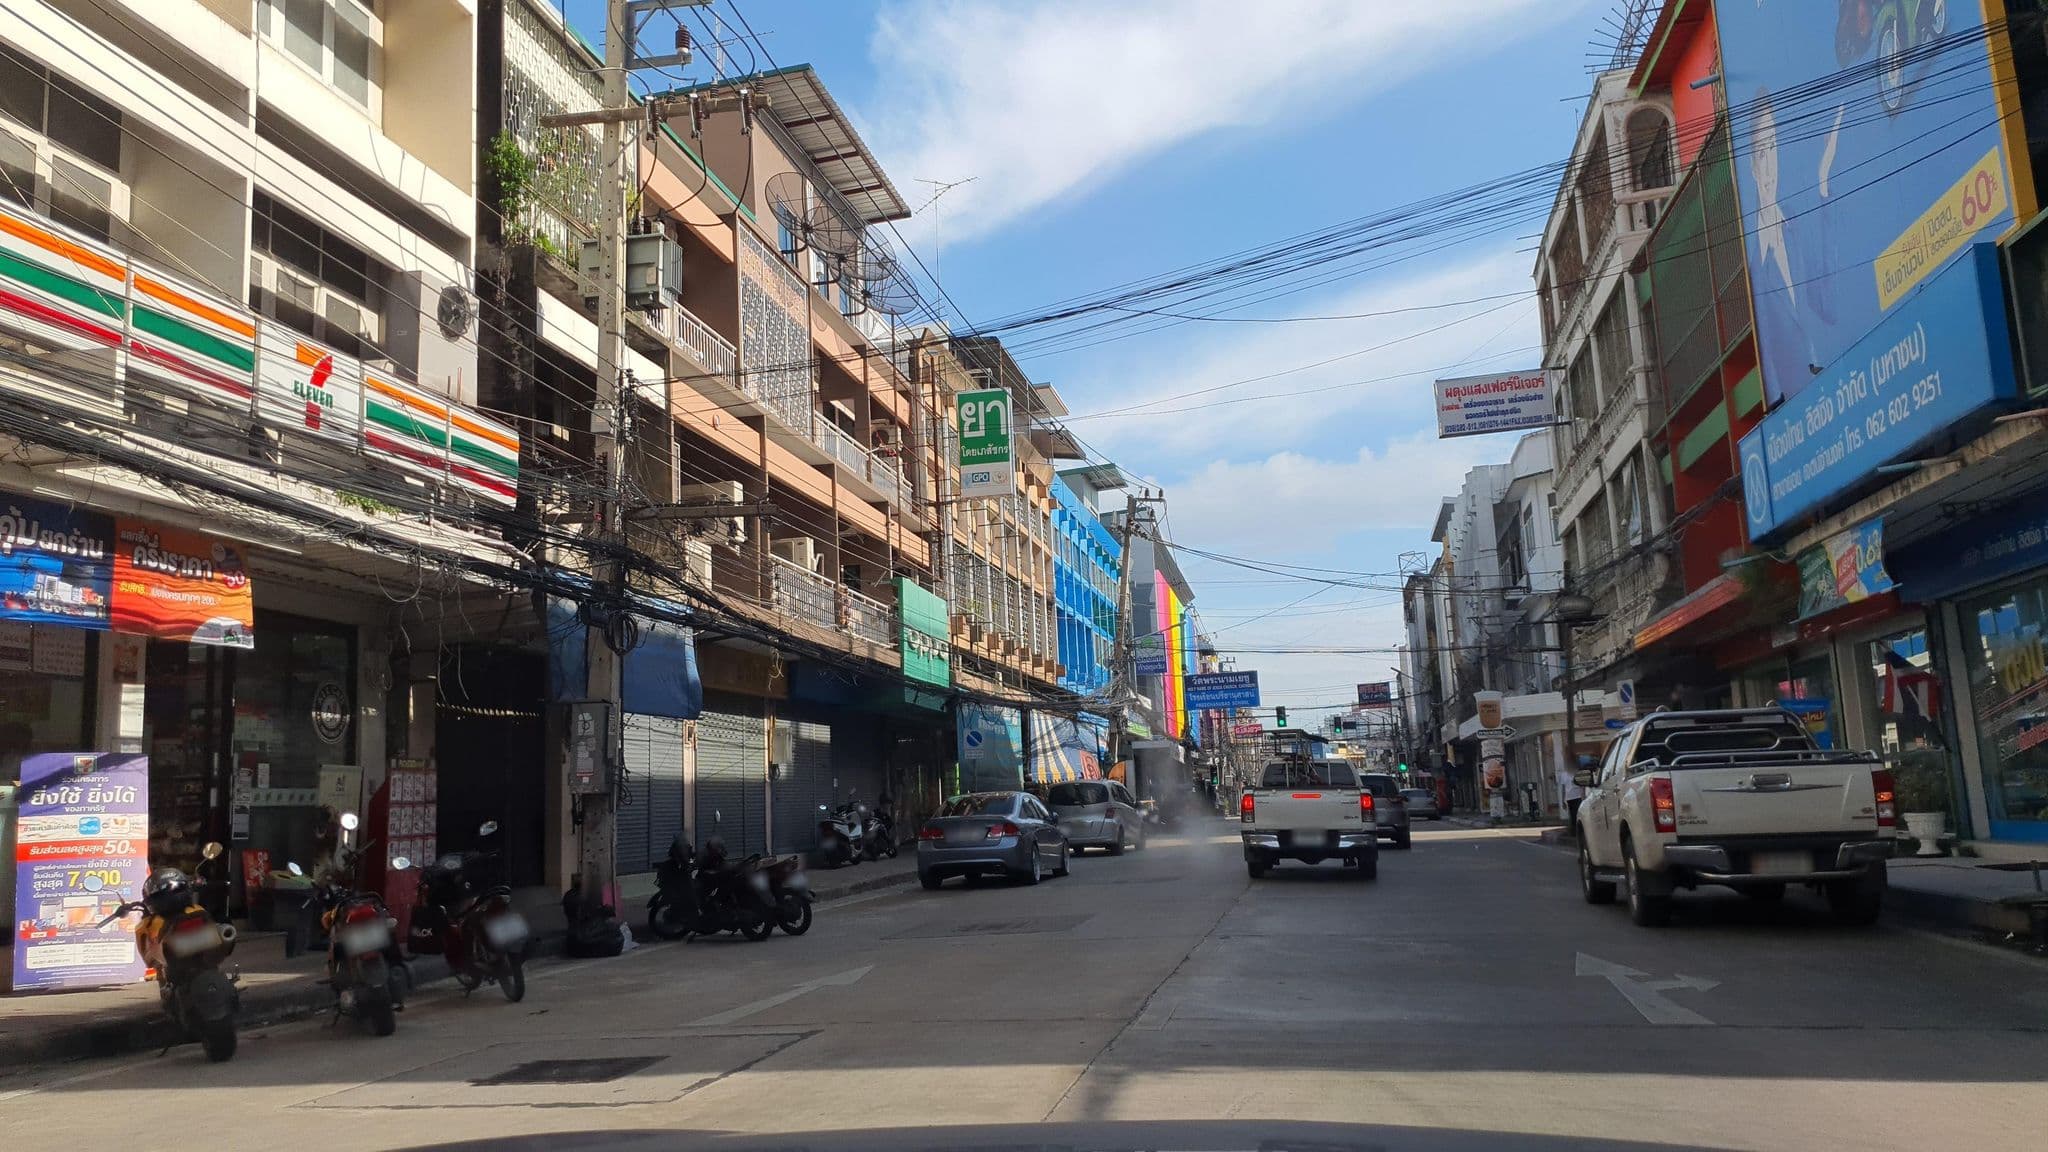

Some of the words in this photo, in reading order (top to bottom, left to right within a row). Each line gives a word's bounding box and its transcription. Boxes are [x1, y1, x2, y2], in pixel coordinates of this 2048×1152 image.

[1445, 372, 1546, 401] ผดุงแสงเฟอร์นิเจอร์
[1805, 387, 1834, 436] ลิสซิ่ง
[1836, 371, 1868, 415] จำกัด
[1870, 321, 1927, 397] (มหาชน)
[960, 399, 1007, 439] ยา
[1845, 426, 1865, 455] โทร.
[1866, 409, 1886, 440] 062
[1888, 396, 1911, 426] 602
[1912, 370, 1943, 412] 9251
[961, 443, 1009, 458] โดยเภสัชกร
[972, 473, 989, 482] GPO
[132, 534, 214, 579] ครึ่งราคา
[1191, 673, 1250, 685] วัดพระนามเยซู
[30, 785, 83, 806] ยิ่งใช้
[87, 784, 138, 804] ยิ่งได้
[64, 805, 106, 813] ของภาครัฐ
[30, 843, 104, 856] รับส่วนลดสูงสุด
[33, 879, 64, 892] สูงสุด
